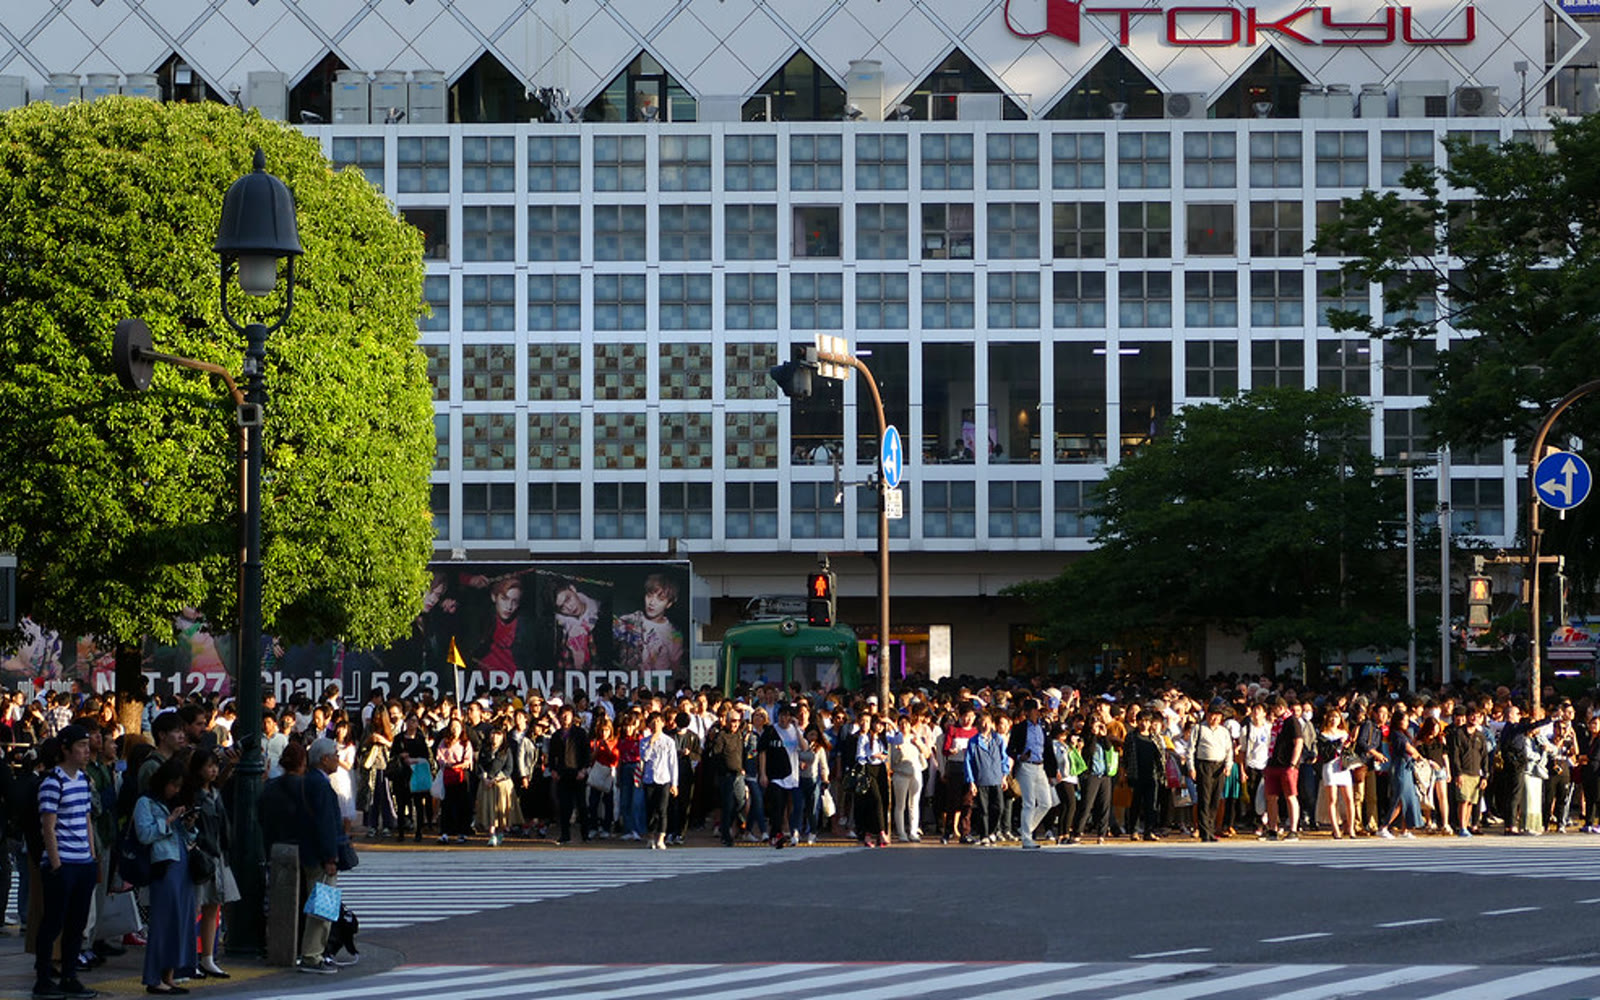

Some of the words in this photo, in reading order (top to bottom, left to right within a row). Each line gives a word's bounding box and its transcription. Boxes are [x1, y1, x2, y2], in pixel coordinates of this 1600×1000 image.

[1084, 5, 1476, 46] TOKYU
[96, 671, 161, 695] NT
[168, 670, 226, 700] 127
